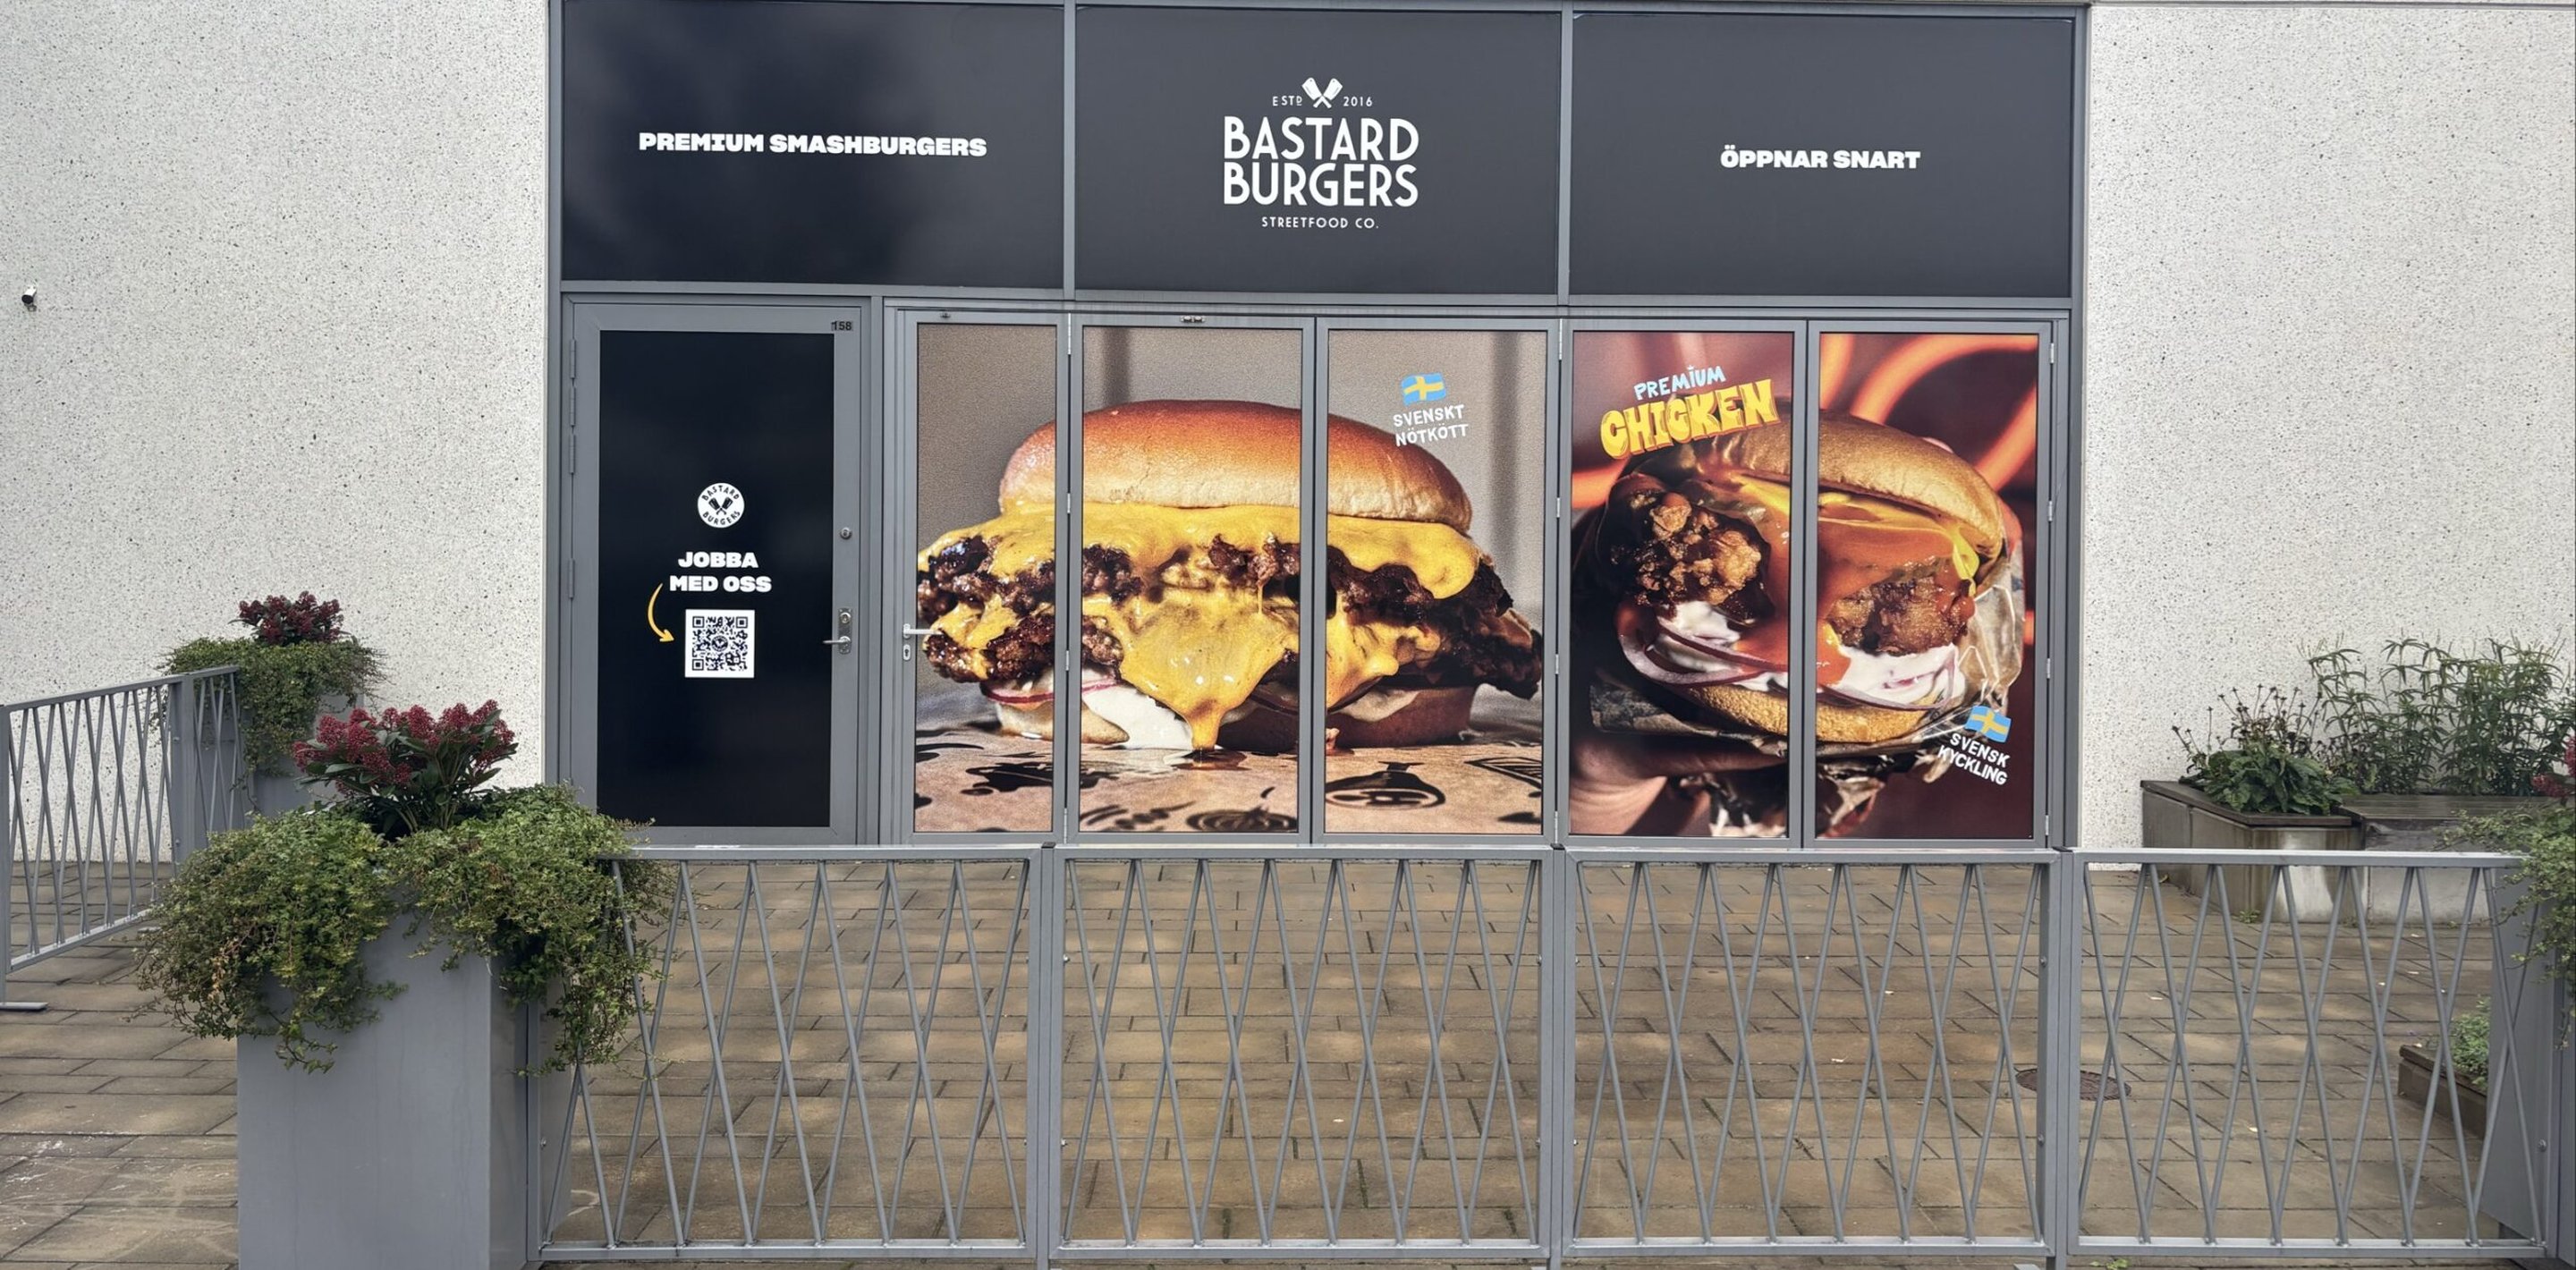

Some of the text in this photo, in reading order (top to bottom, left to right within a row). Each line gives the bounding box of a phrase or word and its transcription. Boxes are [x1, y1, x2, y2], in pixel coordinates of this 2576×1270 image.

[1343, 96, 1373, 106] 2016
[639, 132, 987, 157] PREMIUM SMASHBURGERS
[1224, 115, 1419, 161] BASTARD
[1720, 144, 1921, 169] ÖPPNAR SNART
[1224, 161, 1419, 207] BURGERS
[1262, 216, 1379, 229] STREETFOOD CO.
[831, 320, 852, 331] 158
[1393, 404, 1464, 427] SVENSKT
[1600, 378, 1781, 460] CHICKEN
[1395, 423, 1469, 446] NÖTKÖTT
[701, 485, 740, 501] BASTARD
[702, 511, 741, 525] BURGERS
[678, 552, 758, 568] JOBBA
[670, 575, 772, 592] MED OSS
[1950, 732, 2011, 767] SVENSK
[1937, 744, 2008, 785] KYCKLING
